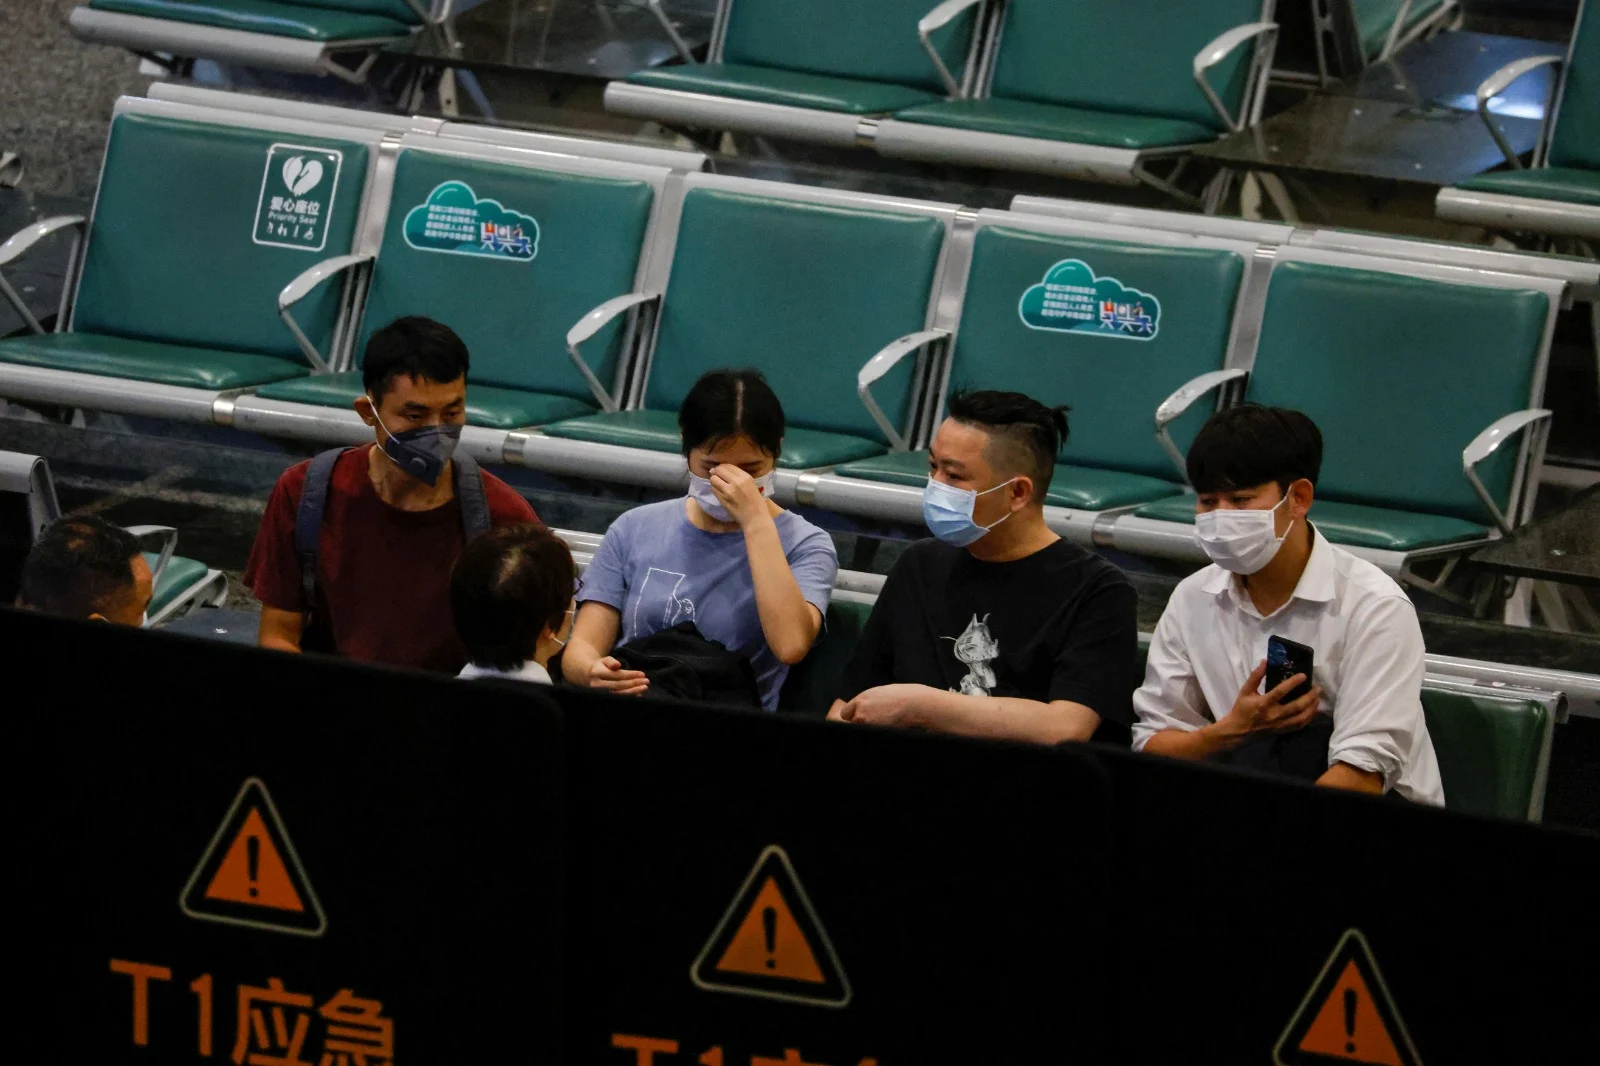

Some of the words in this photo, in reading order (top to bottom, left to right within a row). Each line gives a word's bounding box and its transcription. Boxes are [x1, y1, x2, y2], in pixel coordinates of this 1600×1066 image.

[270, 196, 321, 215] 爱心座位
[268, 211, 297, 224] Priority
[299, 215, 317, 225] Seat
